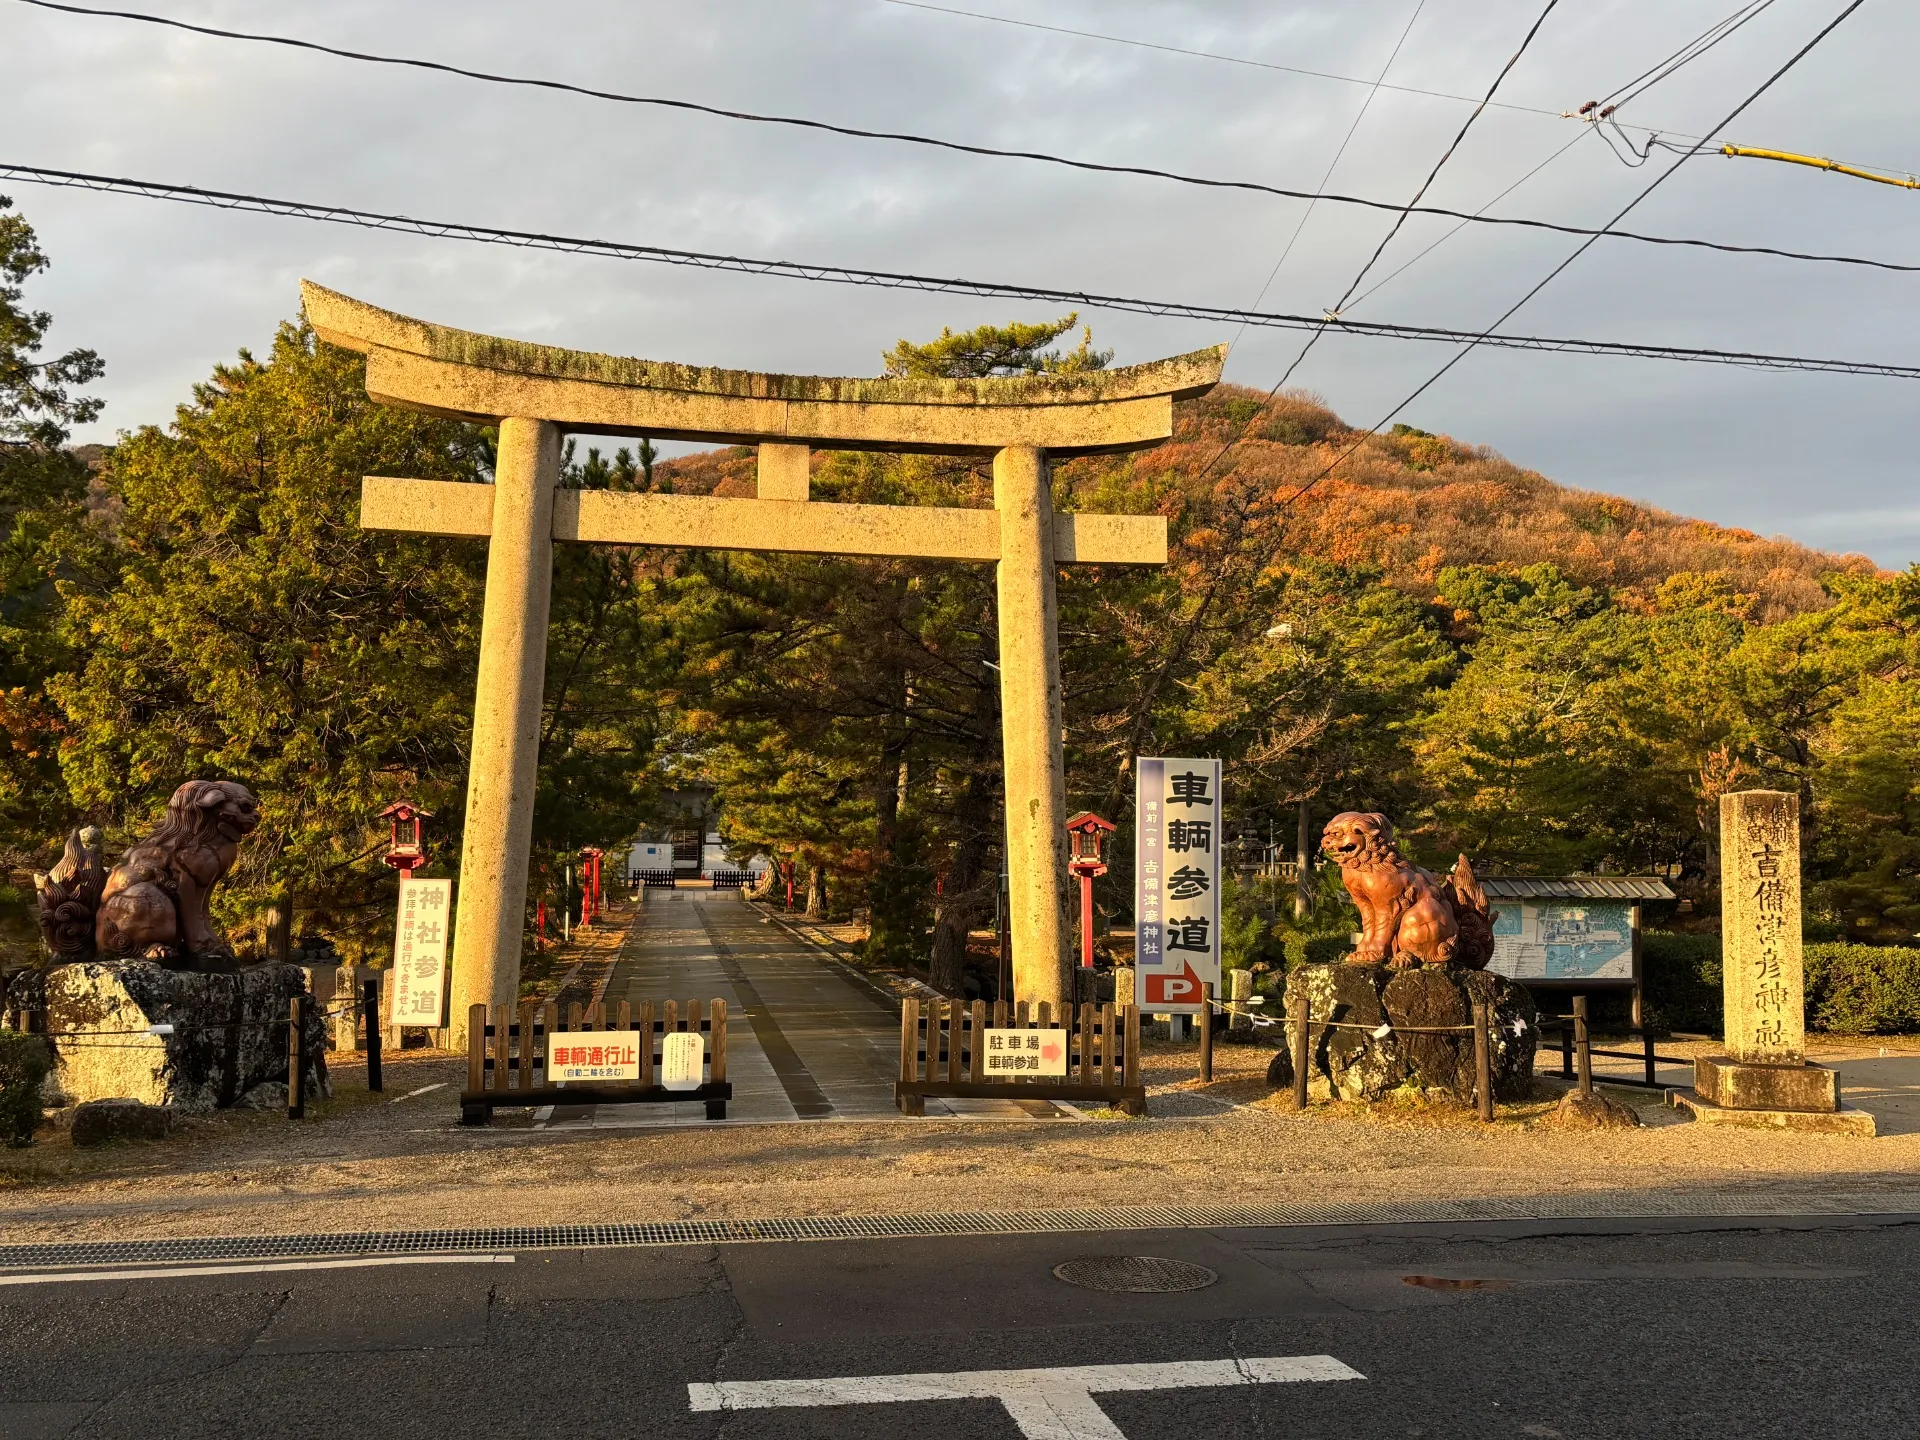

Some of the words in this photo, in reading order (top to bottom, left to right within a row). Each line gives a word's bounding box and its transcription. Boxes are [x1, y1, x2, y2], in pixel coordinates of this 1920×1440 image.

[1145, 801, 1158, 847] 備前一宮
[411, 886, 444, 1014] 神社参道
[1163, 979, 1193, 1001] P
[989, 1035, 1039, 1050] 駐車場
